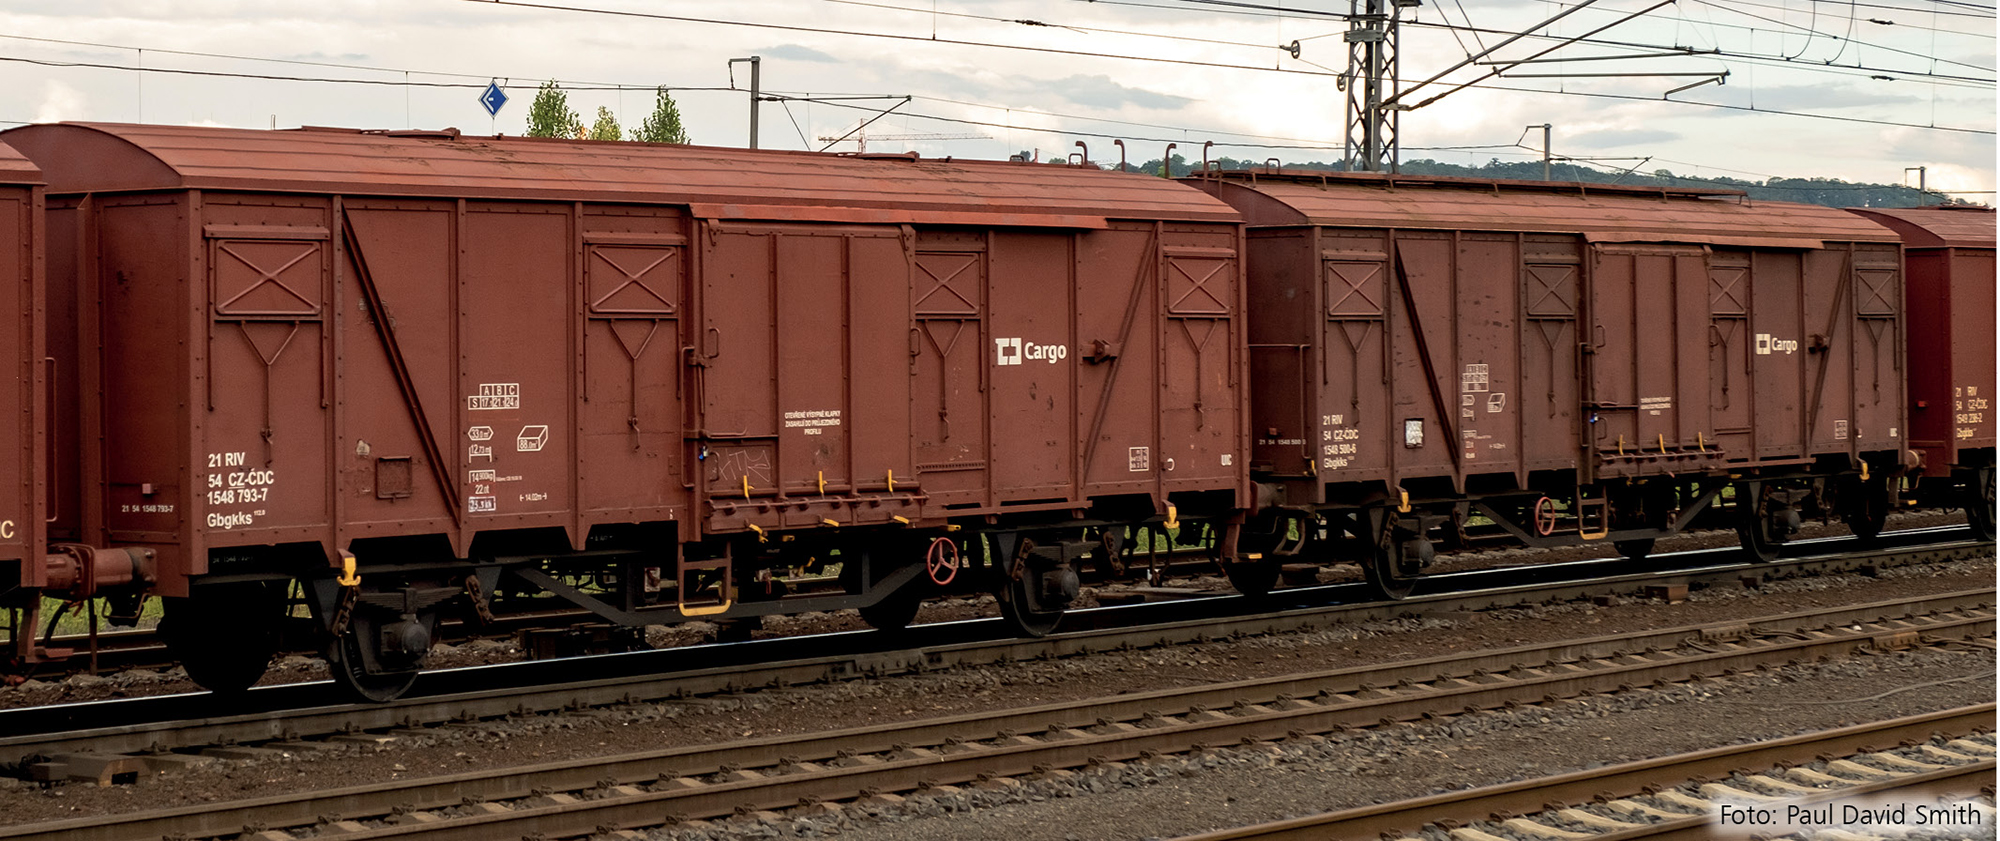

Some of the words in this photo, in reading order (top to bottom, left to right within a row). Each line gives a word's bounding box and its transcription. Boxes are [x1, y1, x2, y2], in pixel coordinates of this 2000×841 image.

[1024, 341, 1067, 364] Cargo
[1771, 337, 1798, 355] Cargo
[484, 386, 490, 396] A
[496, 385, 502, 396] B
[508, 385, 515, 395] C
[472, 398, 478, 408] S
[1323, 415, 1330, 425] 21
[1331, 414, 1343, 425] RIV
[1323, 430, 1331, 441] 54
[1333, 427, 1359, 442] CZ-ČDC
[208, 453, 222, 468] 21
[225, 452, 246, 467] RIV
[208, 474, 223, 488] 54
[228, 468, 275, 489] CZ-ČDC
[207, 490, 235, 505] 1548
[237, 488, 268, 503] 793-7
[121, 504, 130, 513] 21
[131, 504, 140, 513] 54
[207, 511, 253, 529] Gbgkks
